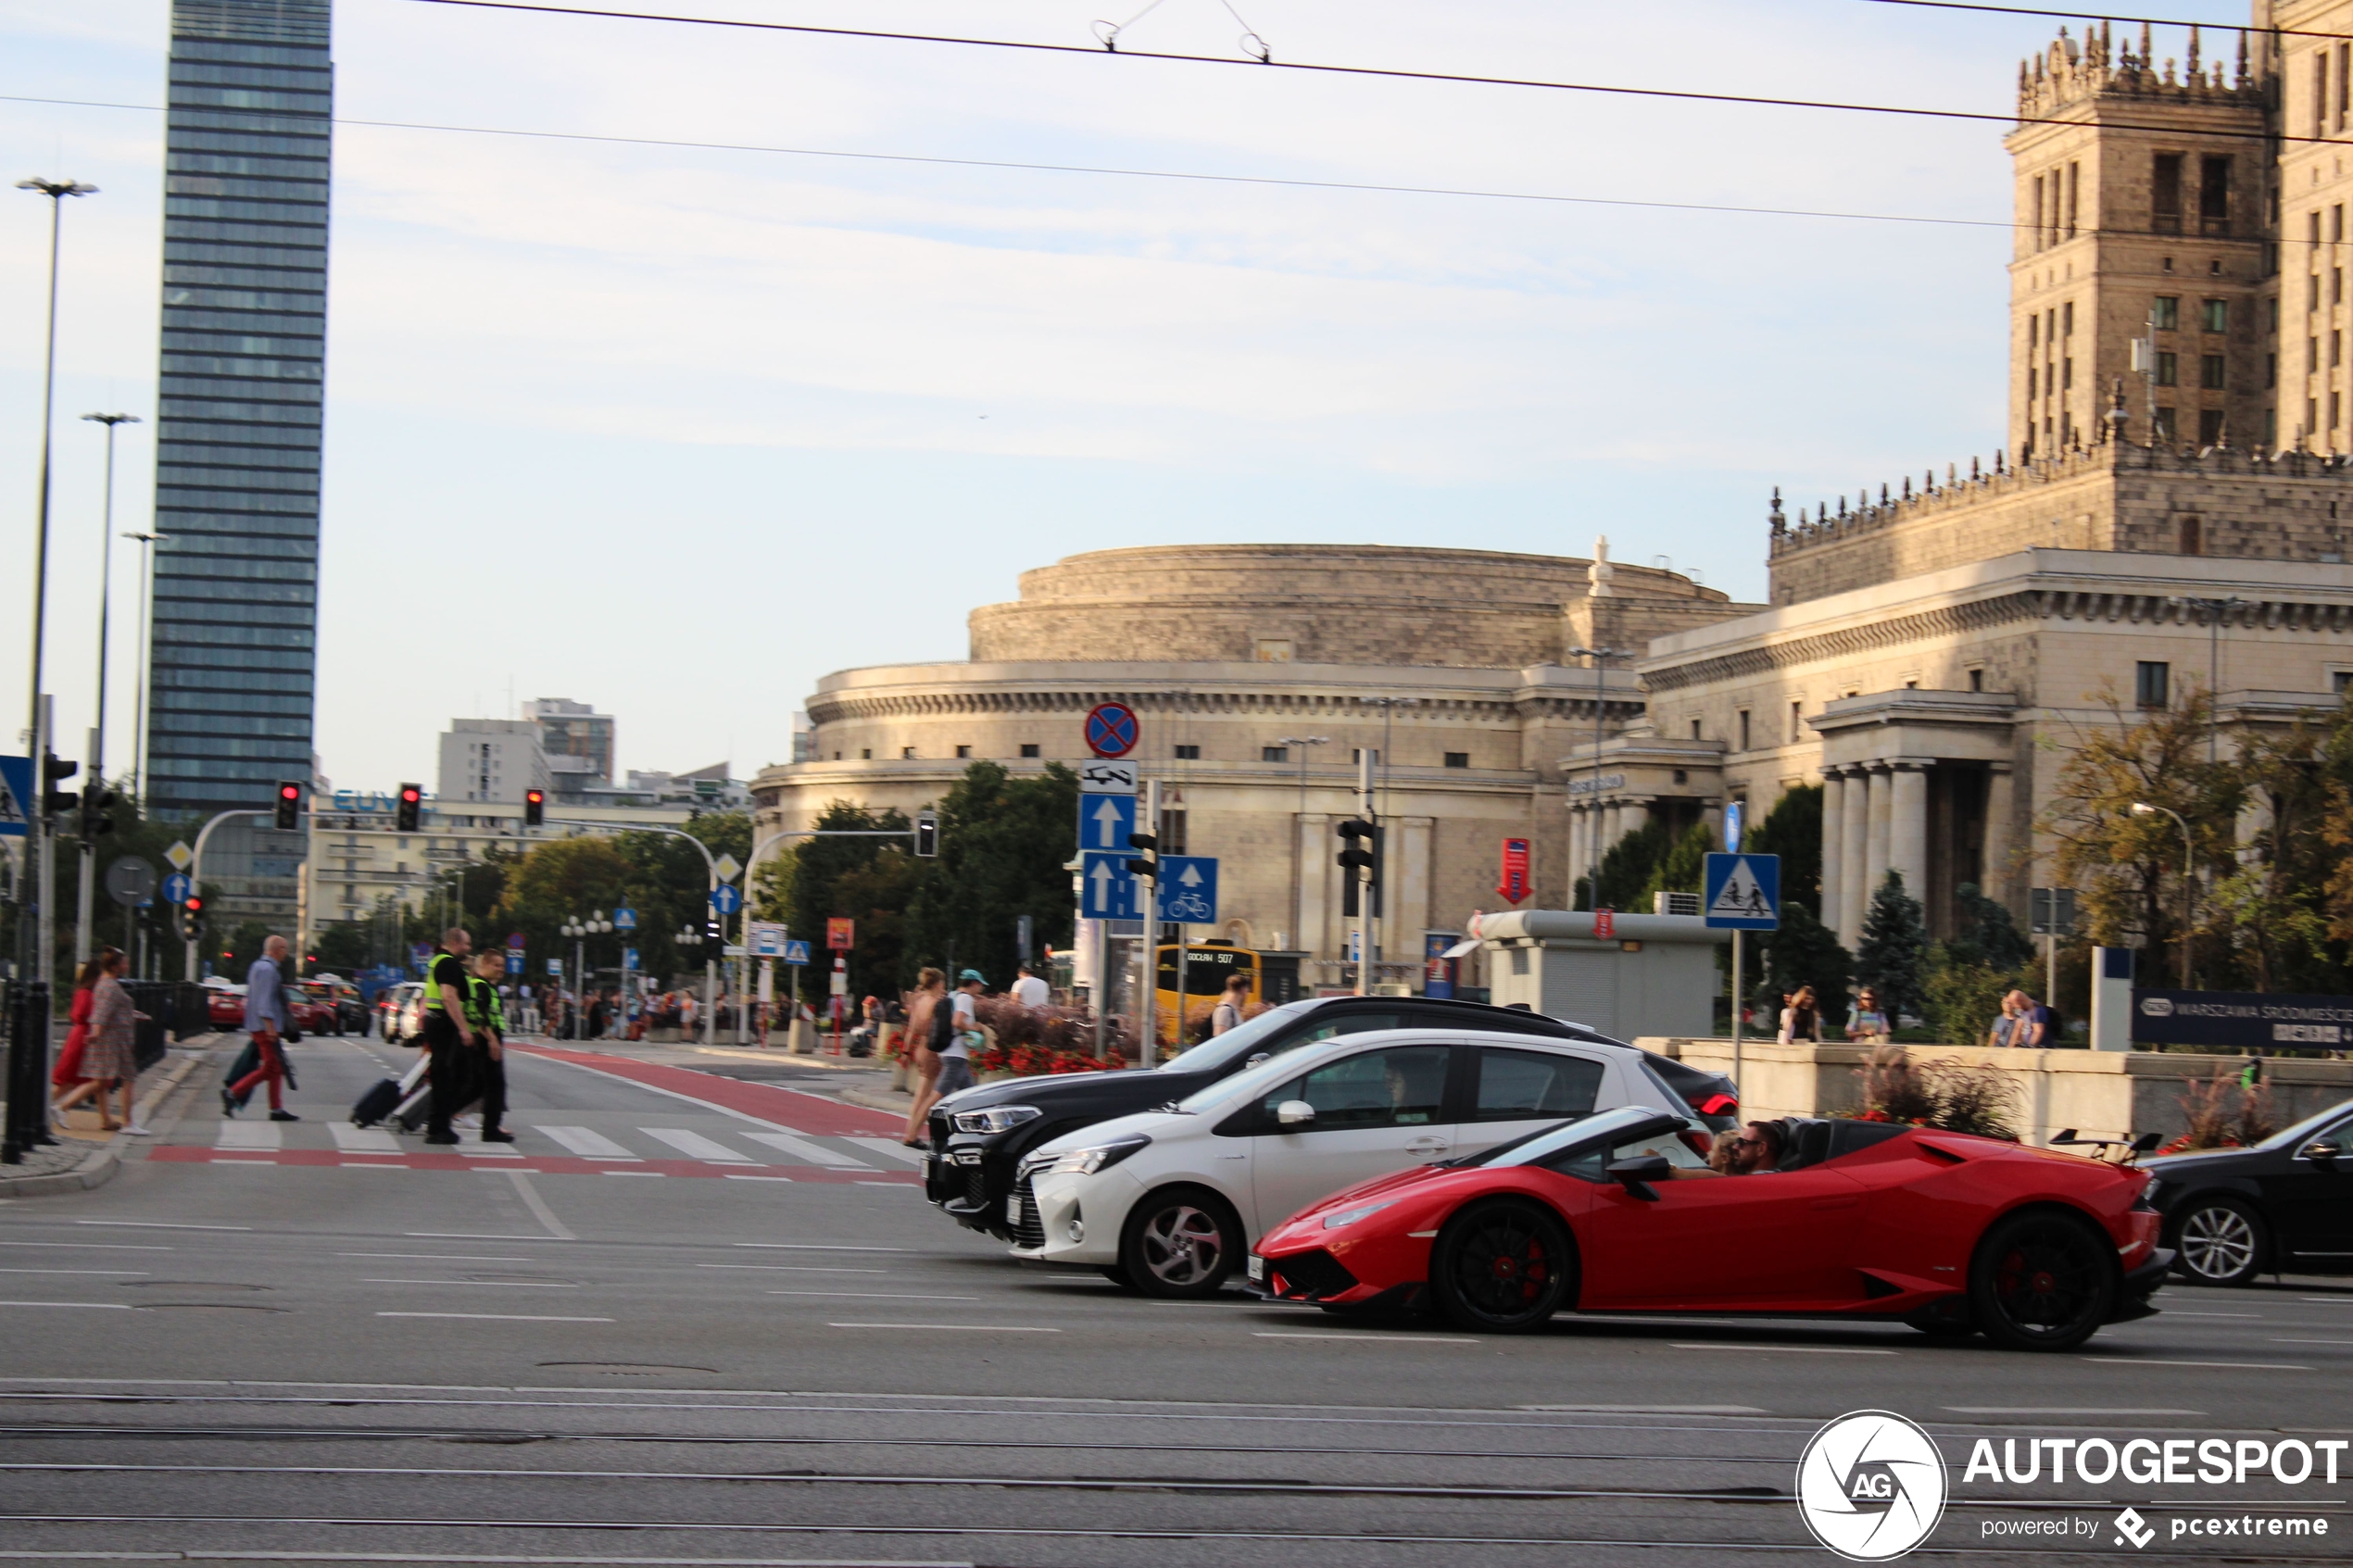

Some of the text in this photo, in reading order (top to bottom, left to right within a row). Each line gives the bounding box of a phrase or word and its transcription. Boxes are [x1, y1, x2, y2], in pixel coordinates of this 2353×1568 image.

[1188, 953, 1233, 963] GOCŁAW 507
[2175, 1003, 2259, 1018] WARSZAWA
